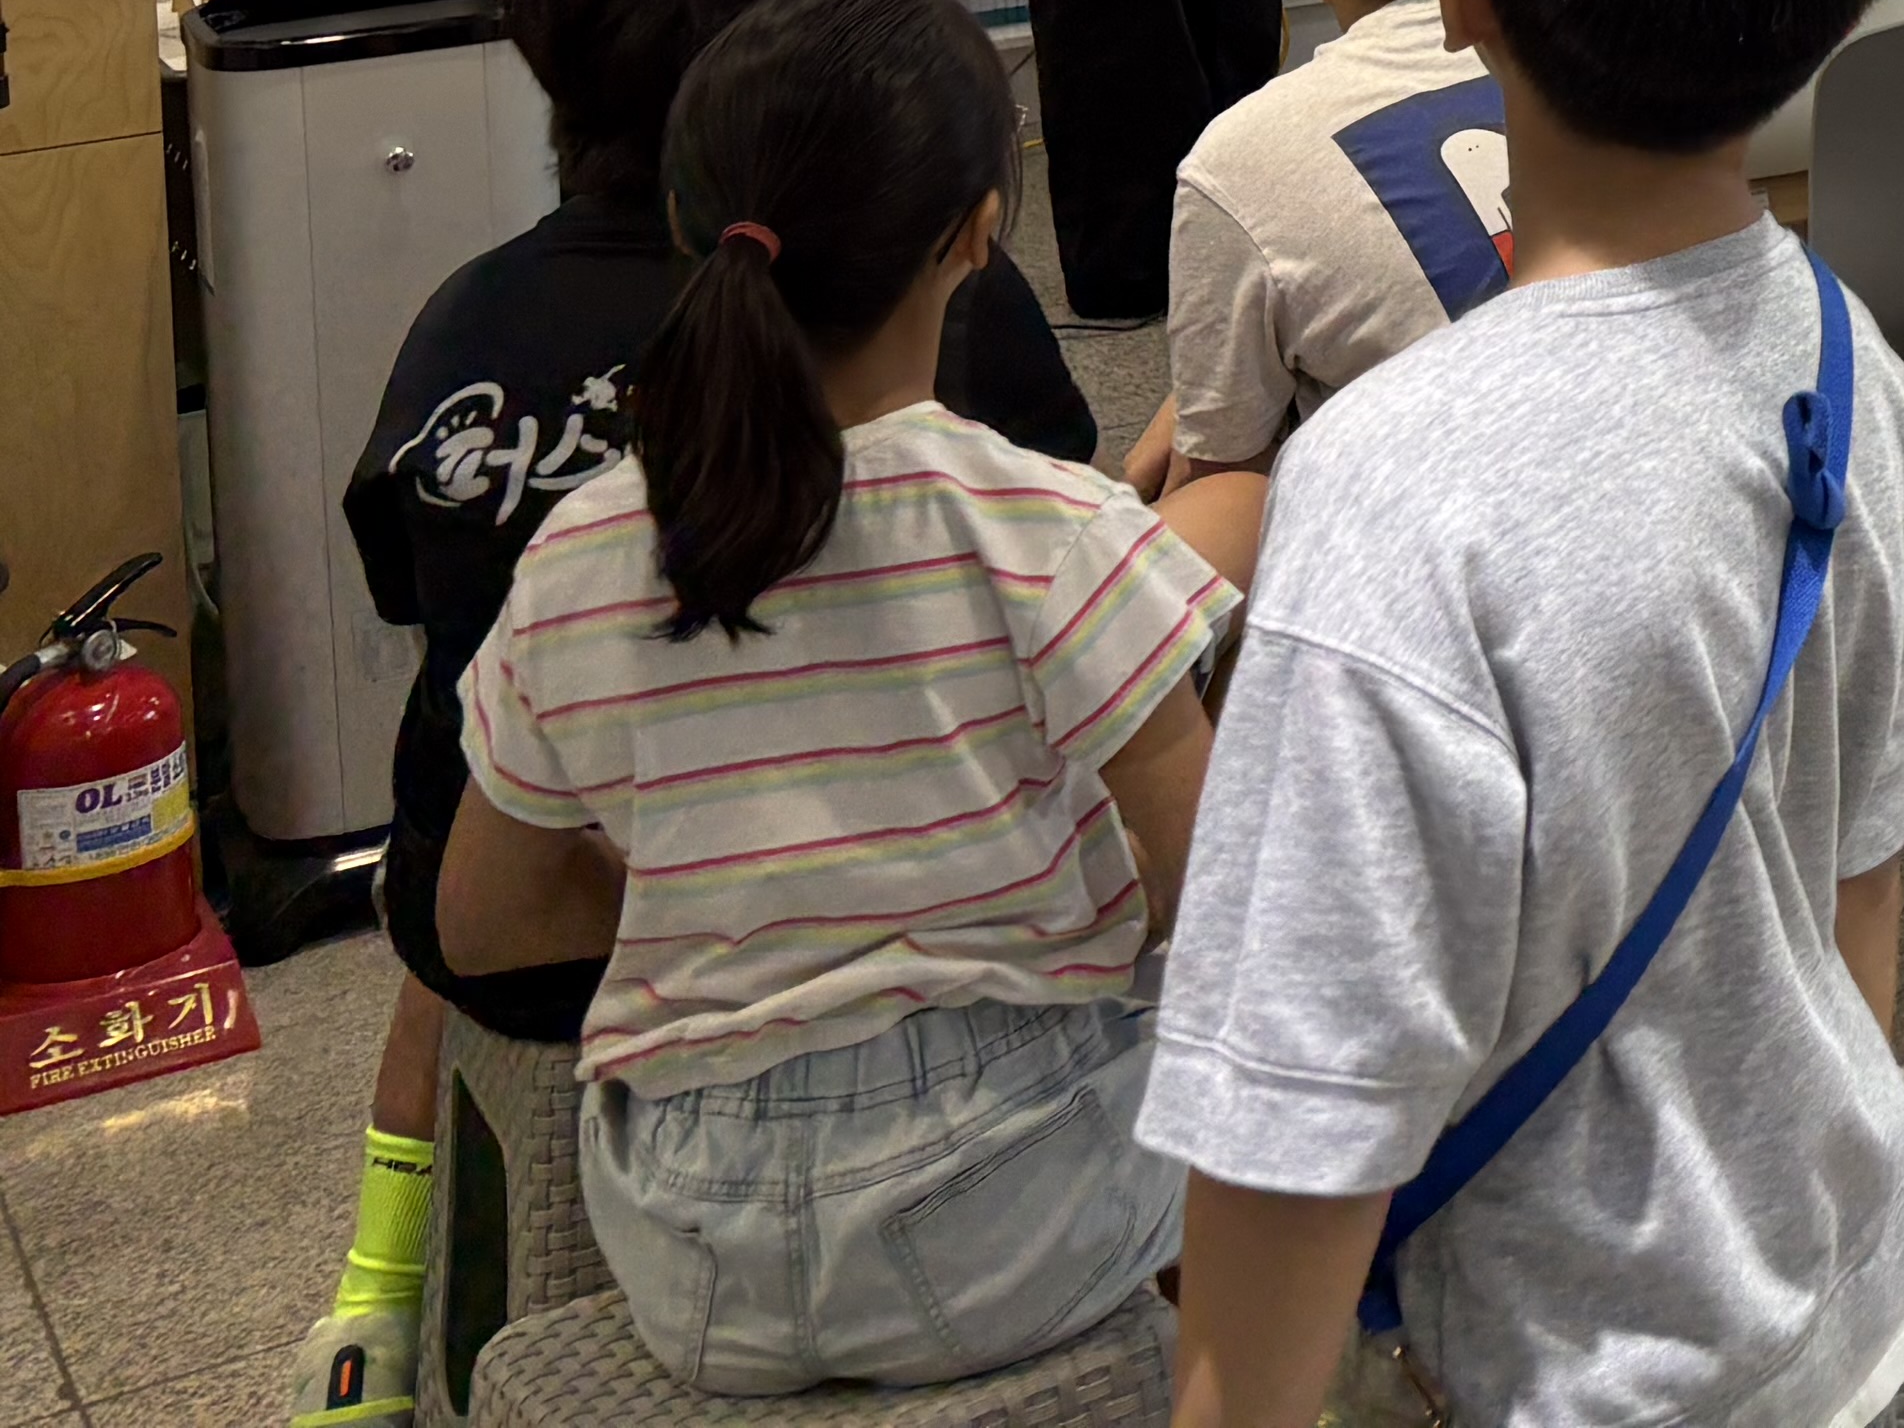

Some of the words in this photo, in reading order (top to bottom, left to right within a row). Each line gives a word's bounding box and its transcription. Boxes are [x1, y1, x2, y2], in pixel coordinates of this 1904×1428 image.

[29, 982, 214, 1069] 소화기
[29, 1066, 75, 1090] FIRE
[79, 1025, 218, 1078] EXTINGUISHER
